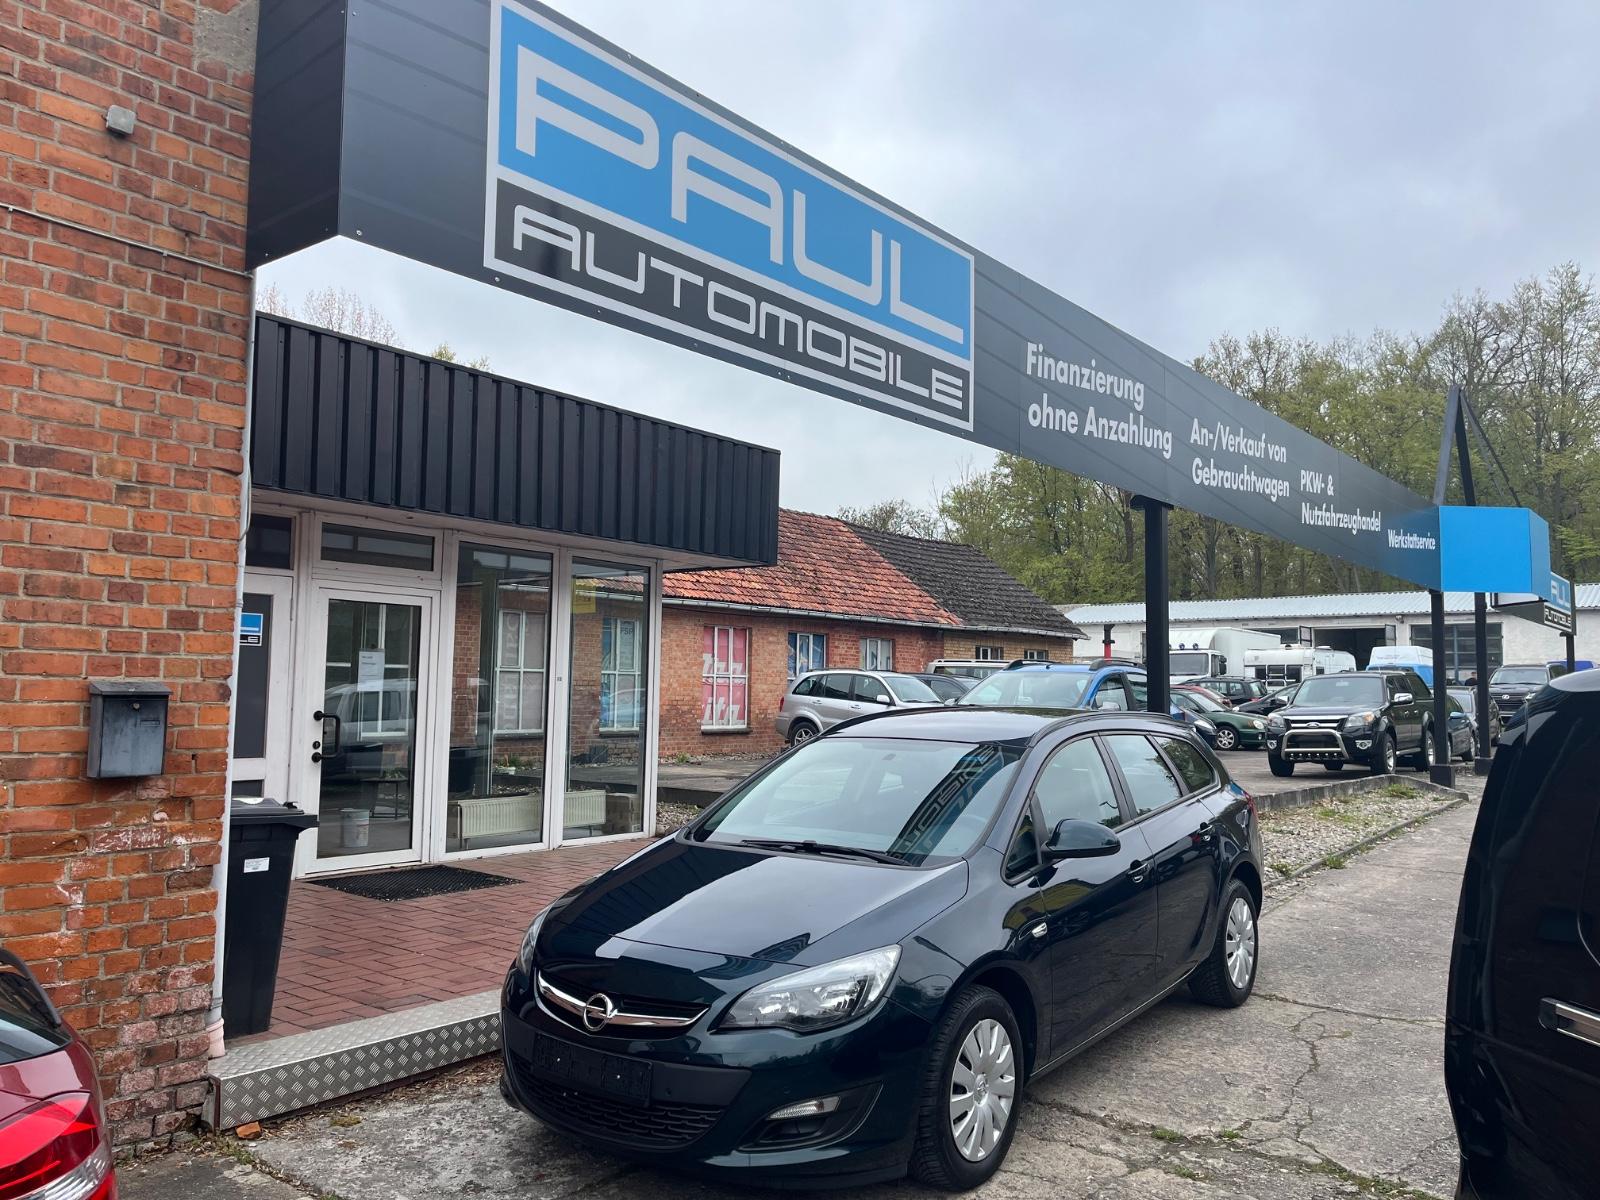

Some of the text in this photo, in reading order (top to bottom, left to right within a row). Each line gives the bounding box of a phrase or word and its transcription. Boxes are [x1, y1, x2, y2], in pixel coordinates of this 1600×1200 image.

[516, 44, 964, 345] PAUL
[513, 204, 963, 410] AUTOMOBILE
[1026, 342, 1145, 411] Finanzierung
[1028, 393, 1173, 459] ohne Anzahlung
[1190, 418, 1287, 463] An-/Verkauf von
[1192, 457, 1290, 502] Gebrauchtwagen
[1300, 470, 1334, 496] PKW- &
[1301, 502, 1381, 535] Nutzfahrzeughandel
[1388, 529, 1436, 550] Werkstattservice
